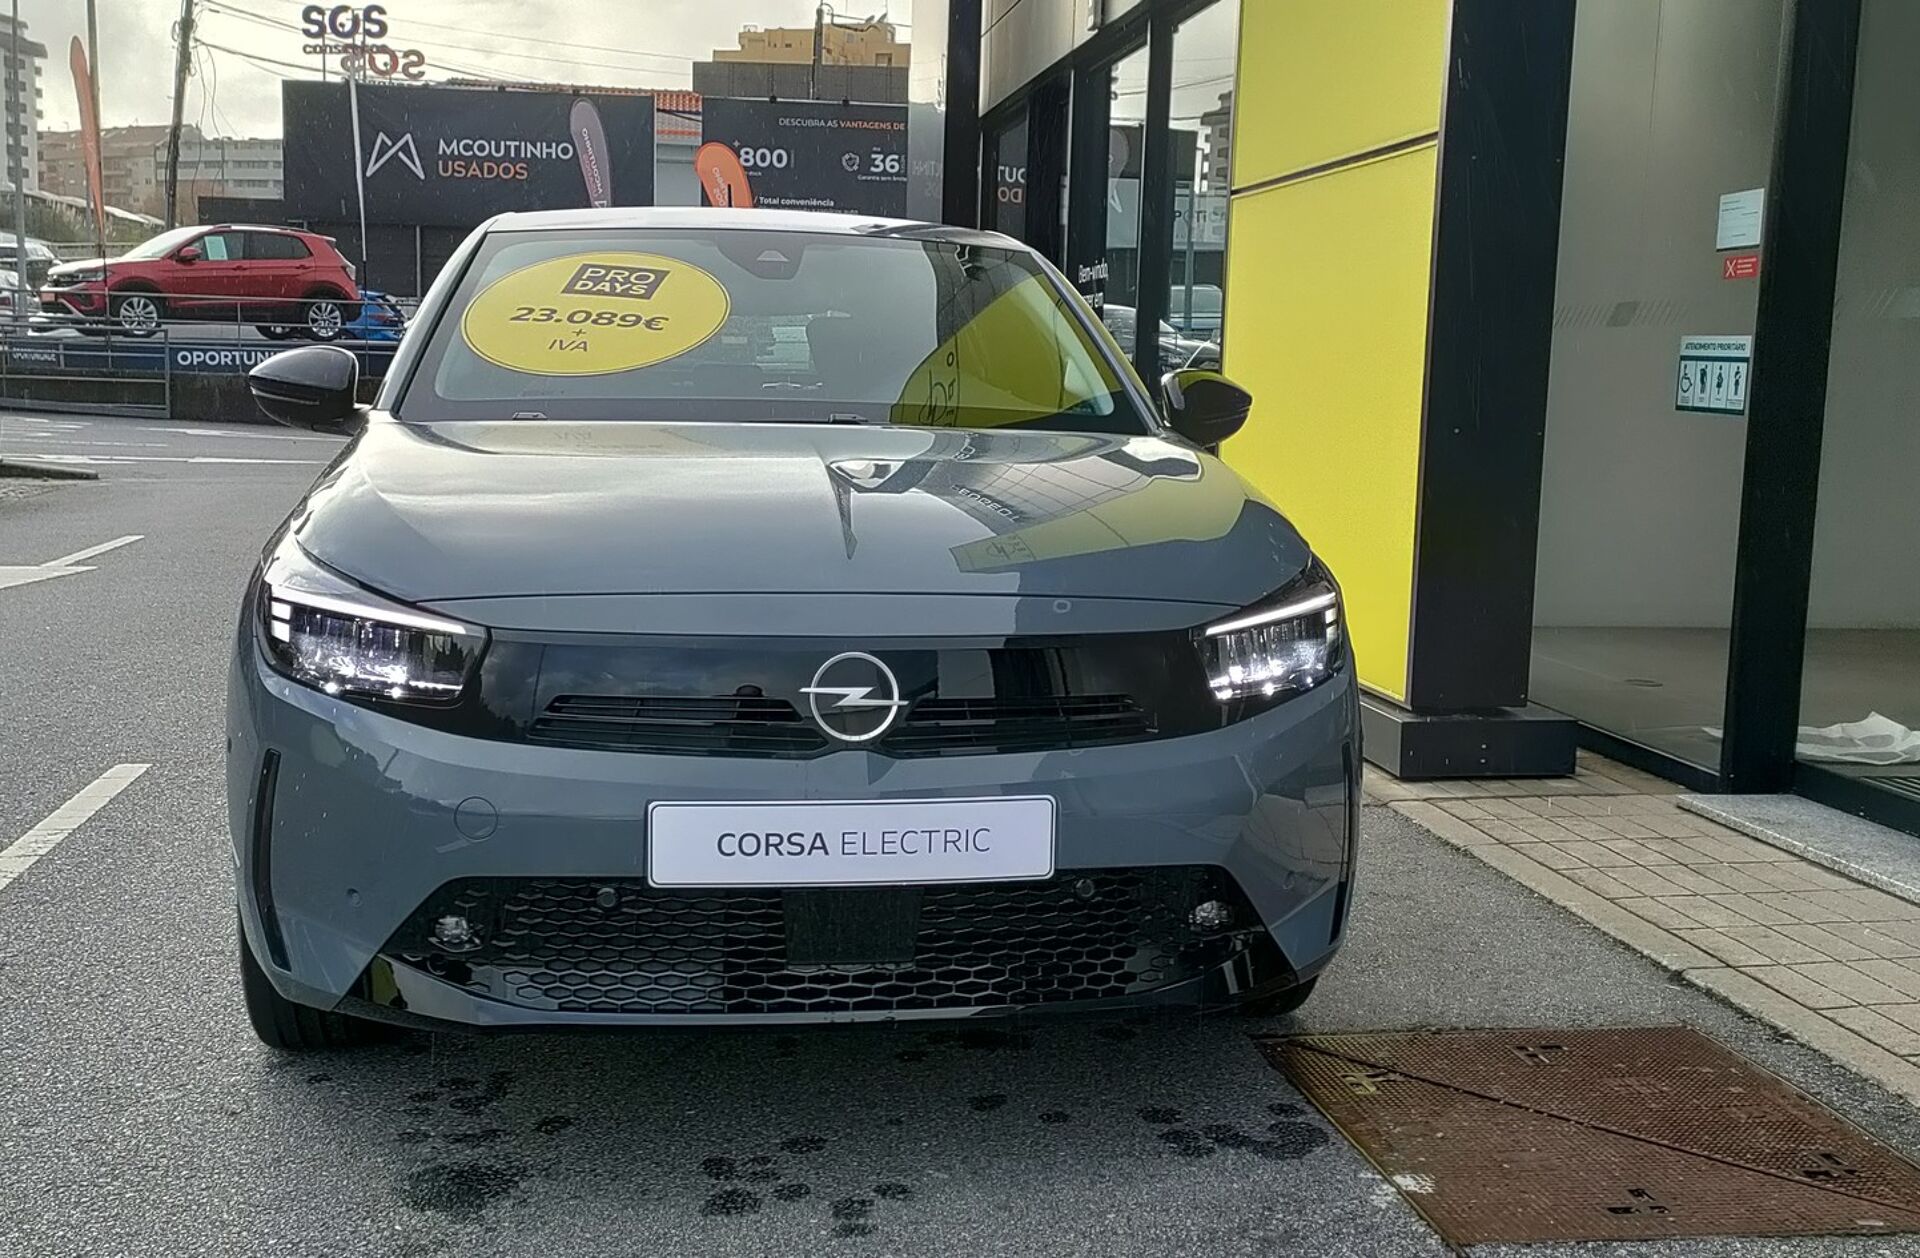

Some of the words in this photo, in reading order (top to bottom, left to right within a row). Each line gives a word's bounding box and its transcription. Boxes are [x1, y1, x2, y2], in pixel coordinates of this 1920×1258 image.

[302, 4, 388, 39] SOS
[779, 117, 825, 128] DESCUBRA
[826, 118, 839, 128] AS
[839, 119, 892, 130] VANTAGENS
[893, 121, 905, 130] DE
[438, 138, 574, 160] MCOUTINHO
[438, 160, 529, 180] USADOS
[870, 153, 900, 173] 36
[759, 197, 779, 205] Total
[781, 198, 835, 207] conveniência
[582, 267, 656, 285] PRO
[573, 280, 649, 295] DAYS
[508, 306, 670, 331] 23.089€
[548, 338, 589, 352] IVA
[177, 350, 277, 366] OPORTUN
[716, 832, 830, 857] CORSA
[841, 828, 991, 856] ELECTRIC
